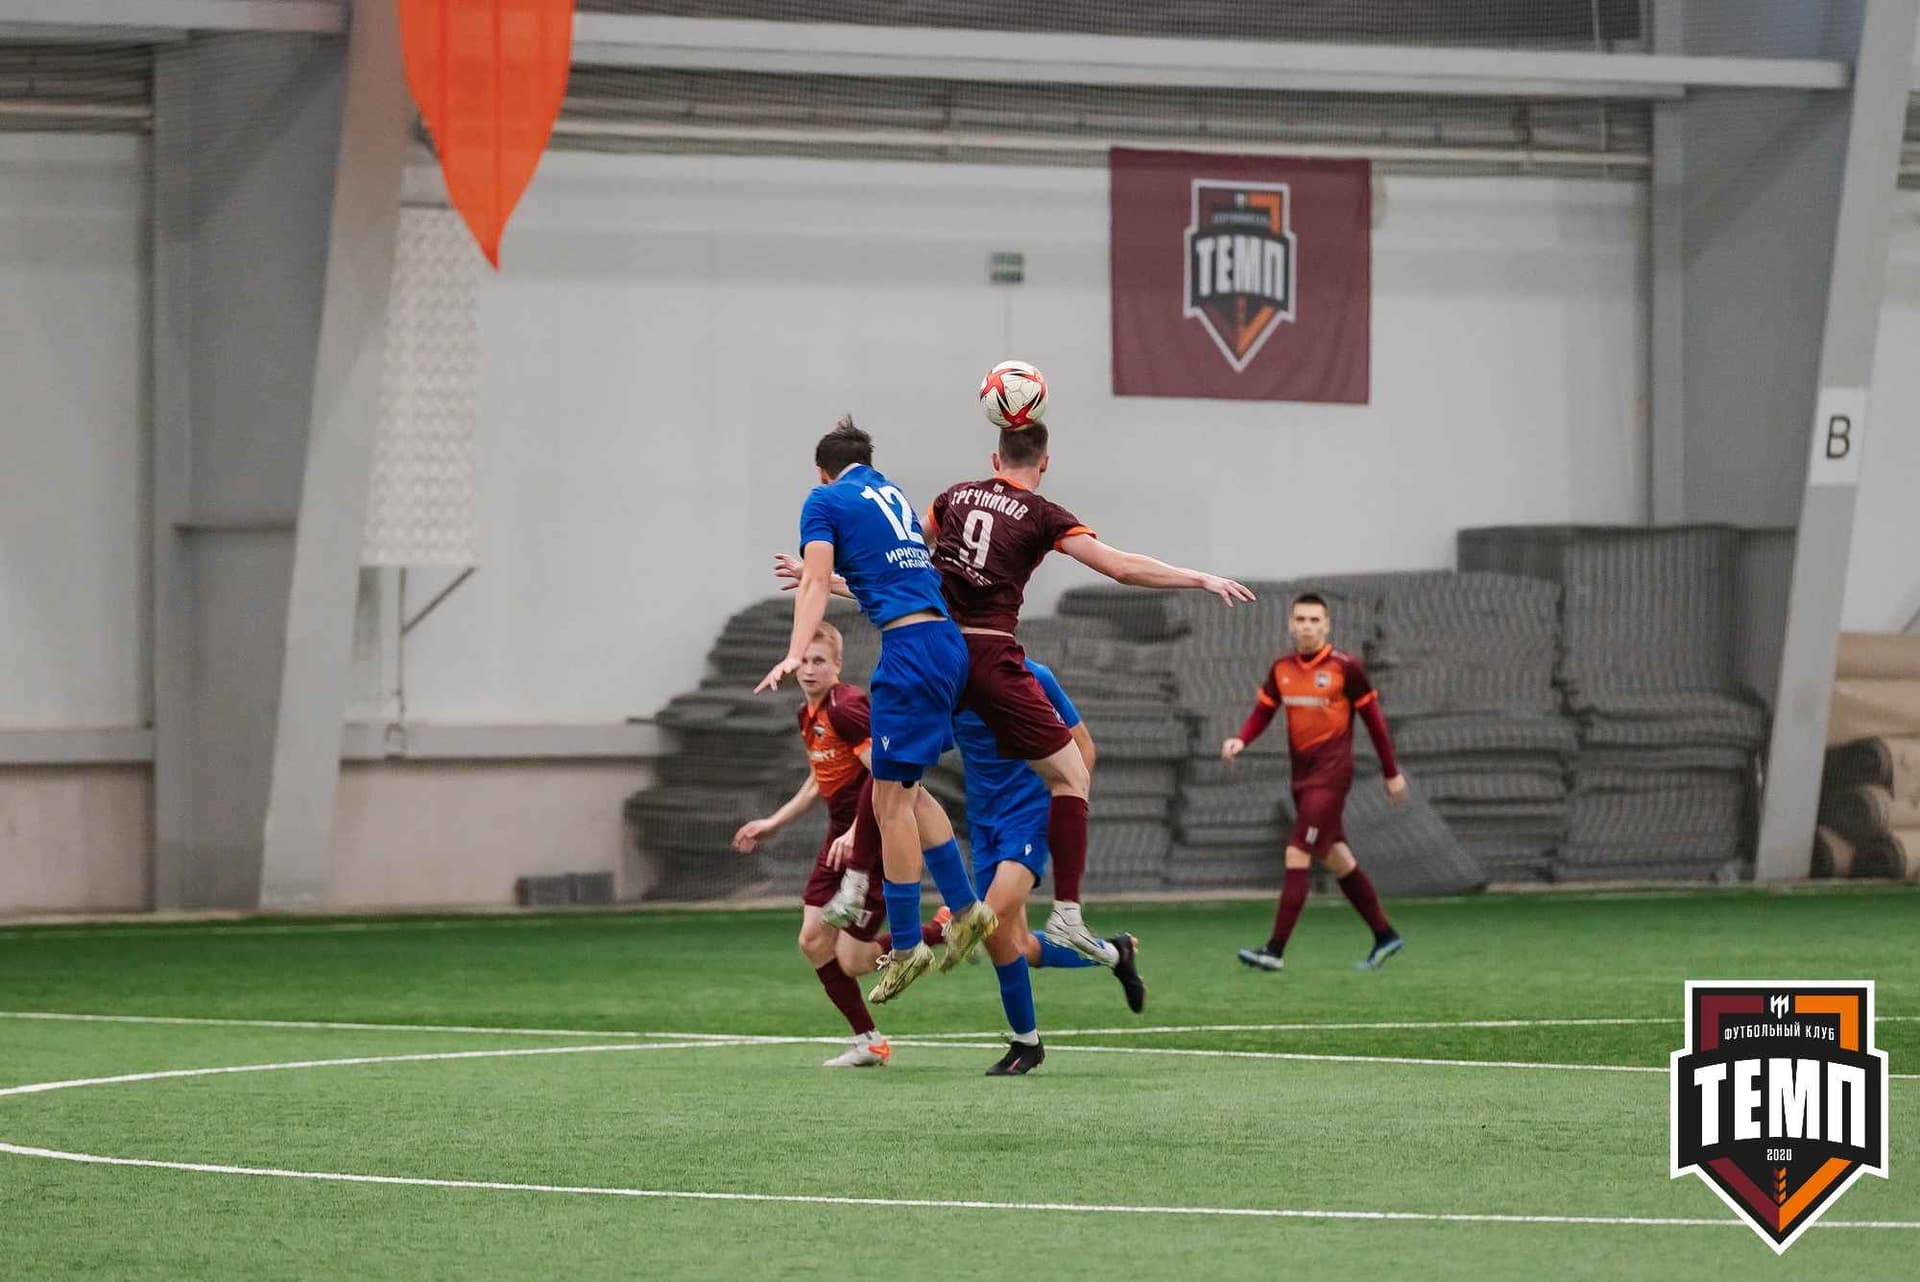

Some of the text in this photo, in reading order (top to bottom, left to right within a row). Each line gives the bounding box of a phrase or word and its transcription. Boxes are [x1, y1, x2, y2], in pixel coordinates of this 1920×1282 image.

[1196, 234, 1286, 301] ТЕМП
[860, 485, 925, 545] 12
[951, 488, 1029, 521] ГРЕЧНИКОВ
[959, 509, 993, 569] 9
